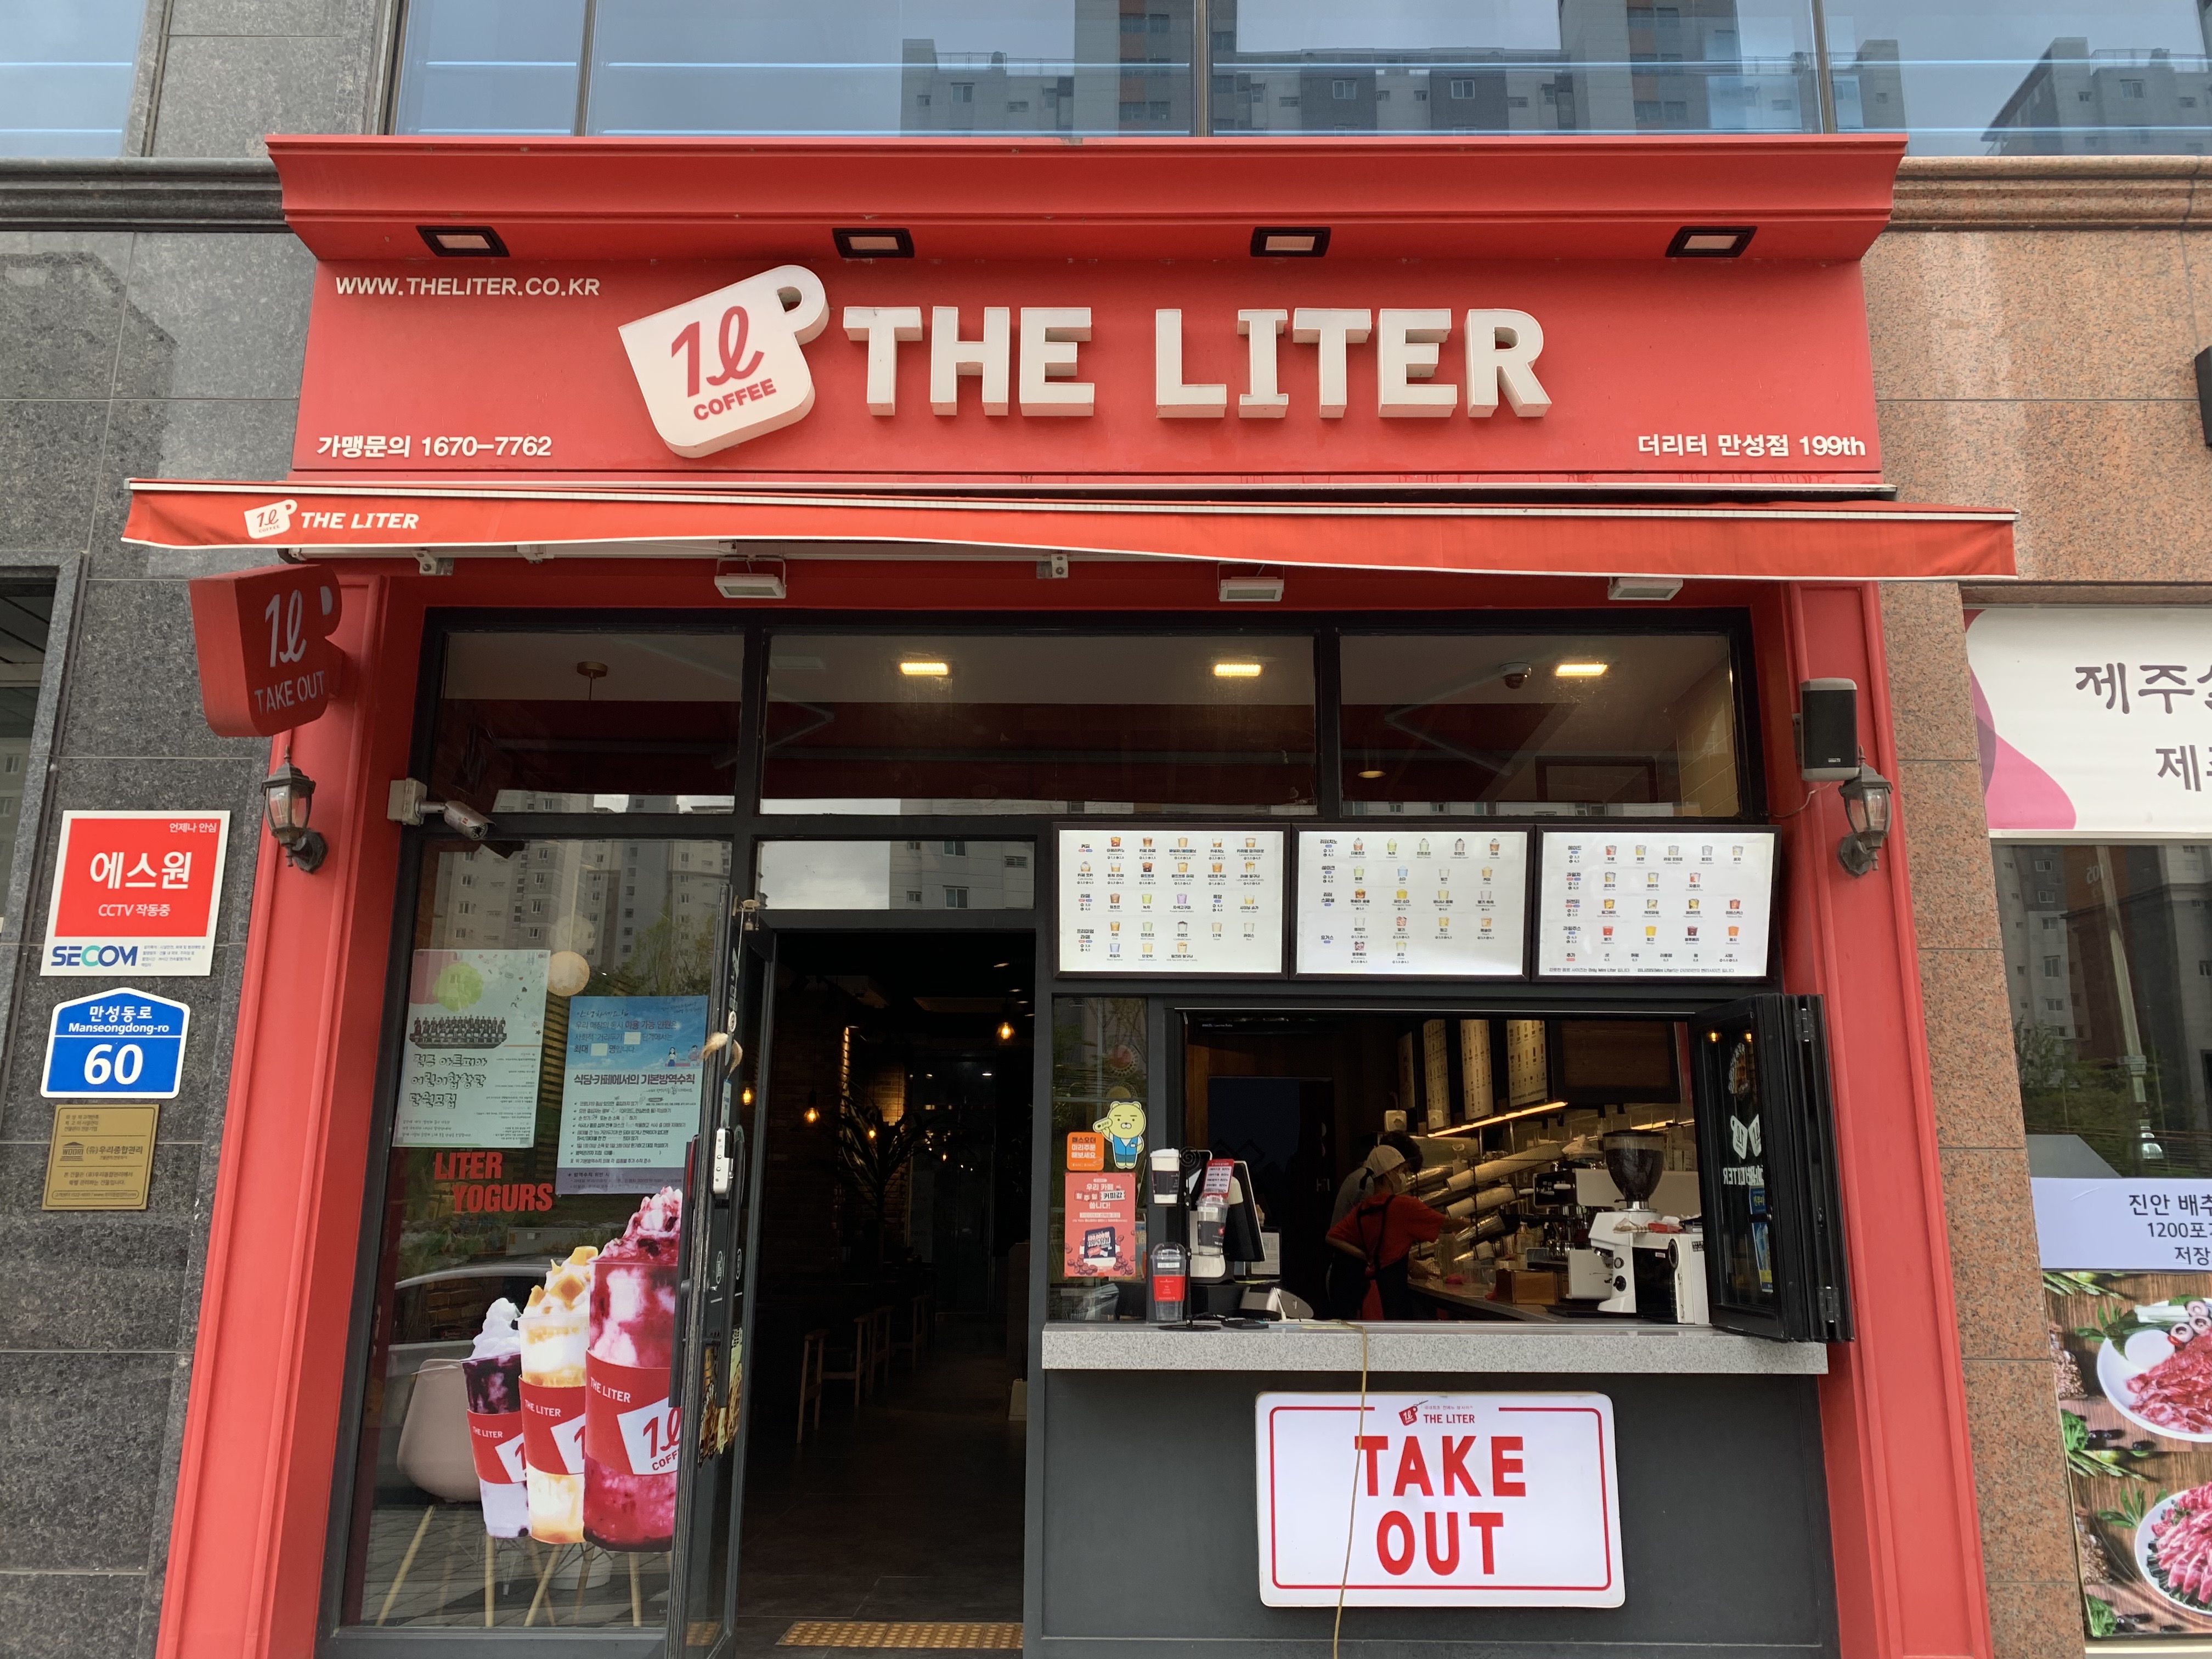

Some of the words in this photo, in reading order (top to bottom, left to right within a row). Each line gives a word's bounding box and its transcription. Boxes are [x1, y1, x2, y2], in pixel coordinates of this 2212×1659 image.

[336, 278, 600, 296] WWW.THELITER.CO.KR
[843, 306, 1094, 416] THE
[1155, 308, 1552, 418] LITER
[693, 379, 776, 421] COFFEE
[317, 435, 410, 458] 가맹문의
[421, 436, 551, 456] 1670-7762
[1638, 434, 1707, 456] 더리터
[1718, 434, 1788, 457] 만성점
[1800, 435, 1866, 456] 199th
[301, 512, 346, 529] THE
[351, 513, 419, 529] LITER
[255, 680, 295, 715] TAKE
[297, 671, 324, 702] OUT
[2155, 745, 2212, 792] 제
[170, 822, 196, 833] 언제나
[199, 823, 217, 833] 안심
[90, 851, 191, 889] 에스원
[98, 905, 133, 916] CCTV
[136, 904, 170, 917] 작동중
[50, 945, 138, 967] SECOM
[89, 1006, 152, 1022] 만성동로
[69, 1023, 169, 1035] Manseongdong-ro
[574, 1045, 588, 1053] 최대
[84, 1044, 143, 1085] 60
[414, 1054, 435, 1067] 전주
[439, 1054, 487, 1066] 아트피아
[411, 1072, 486, 1089] 어린이합창단
[641, 1074, 695, 1085] 기본방역수칙
[409, 1092, 456, 1109] 단원모집
[435, 1152, 503, 1180] LITER
[453, 1183, 553, 1212] YOGURS
[2129, 1194, 2170, 1216] 진안
[2147, 1223, 2212, 1238] 1200포
[590, 1377, 601, 1394] THE
[602, 1385, 630, 1403] LITER
[525, 1400, 534, 1413] THE
[535, 1405, 561, 1417] LITER
[1424, 1414, 1443, 1423] THE
[1447, 1414, 1475, 1423] LITER
[473, 1426, 482, 1436] THE
[482, 1429, 503, 1438] LITER
[652, 1449, 679, 1471] COFF
[1355, 1436, 1526, 1497] TAKE
[1377, 1511, 1503, 1575] OUT
